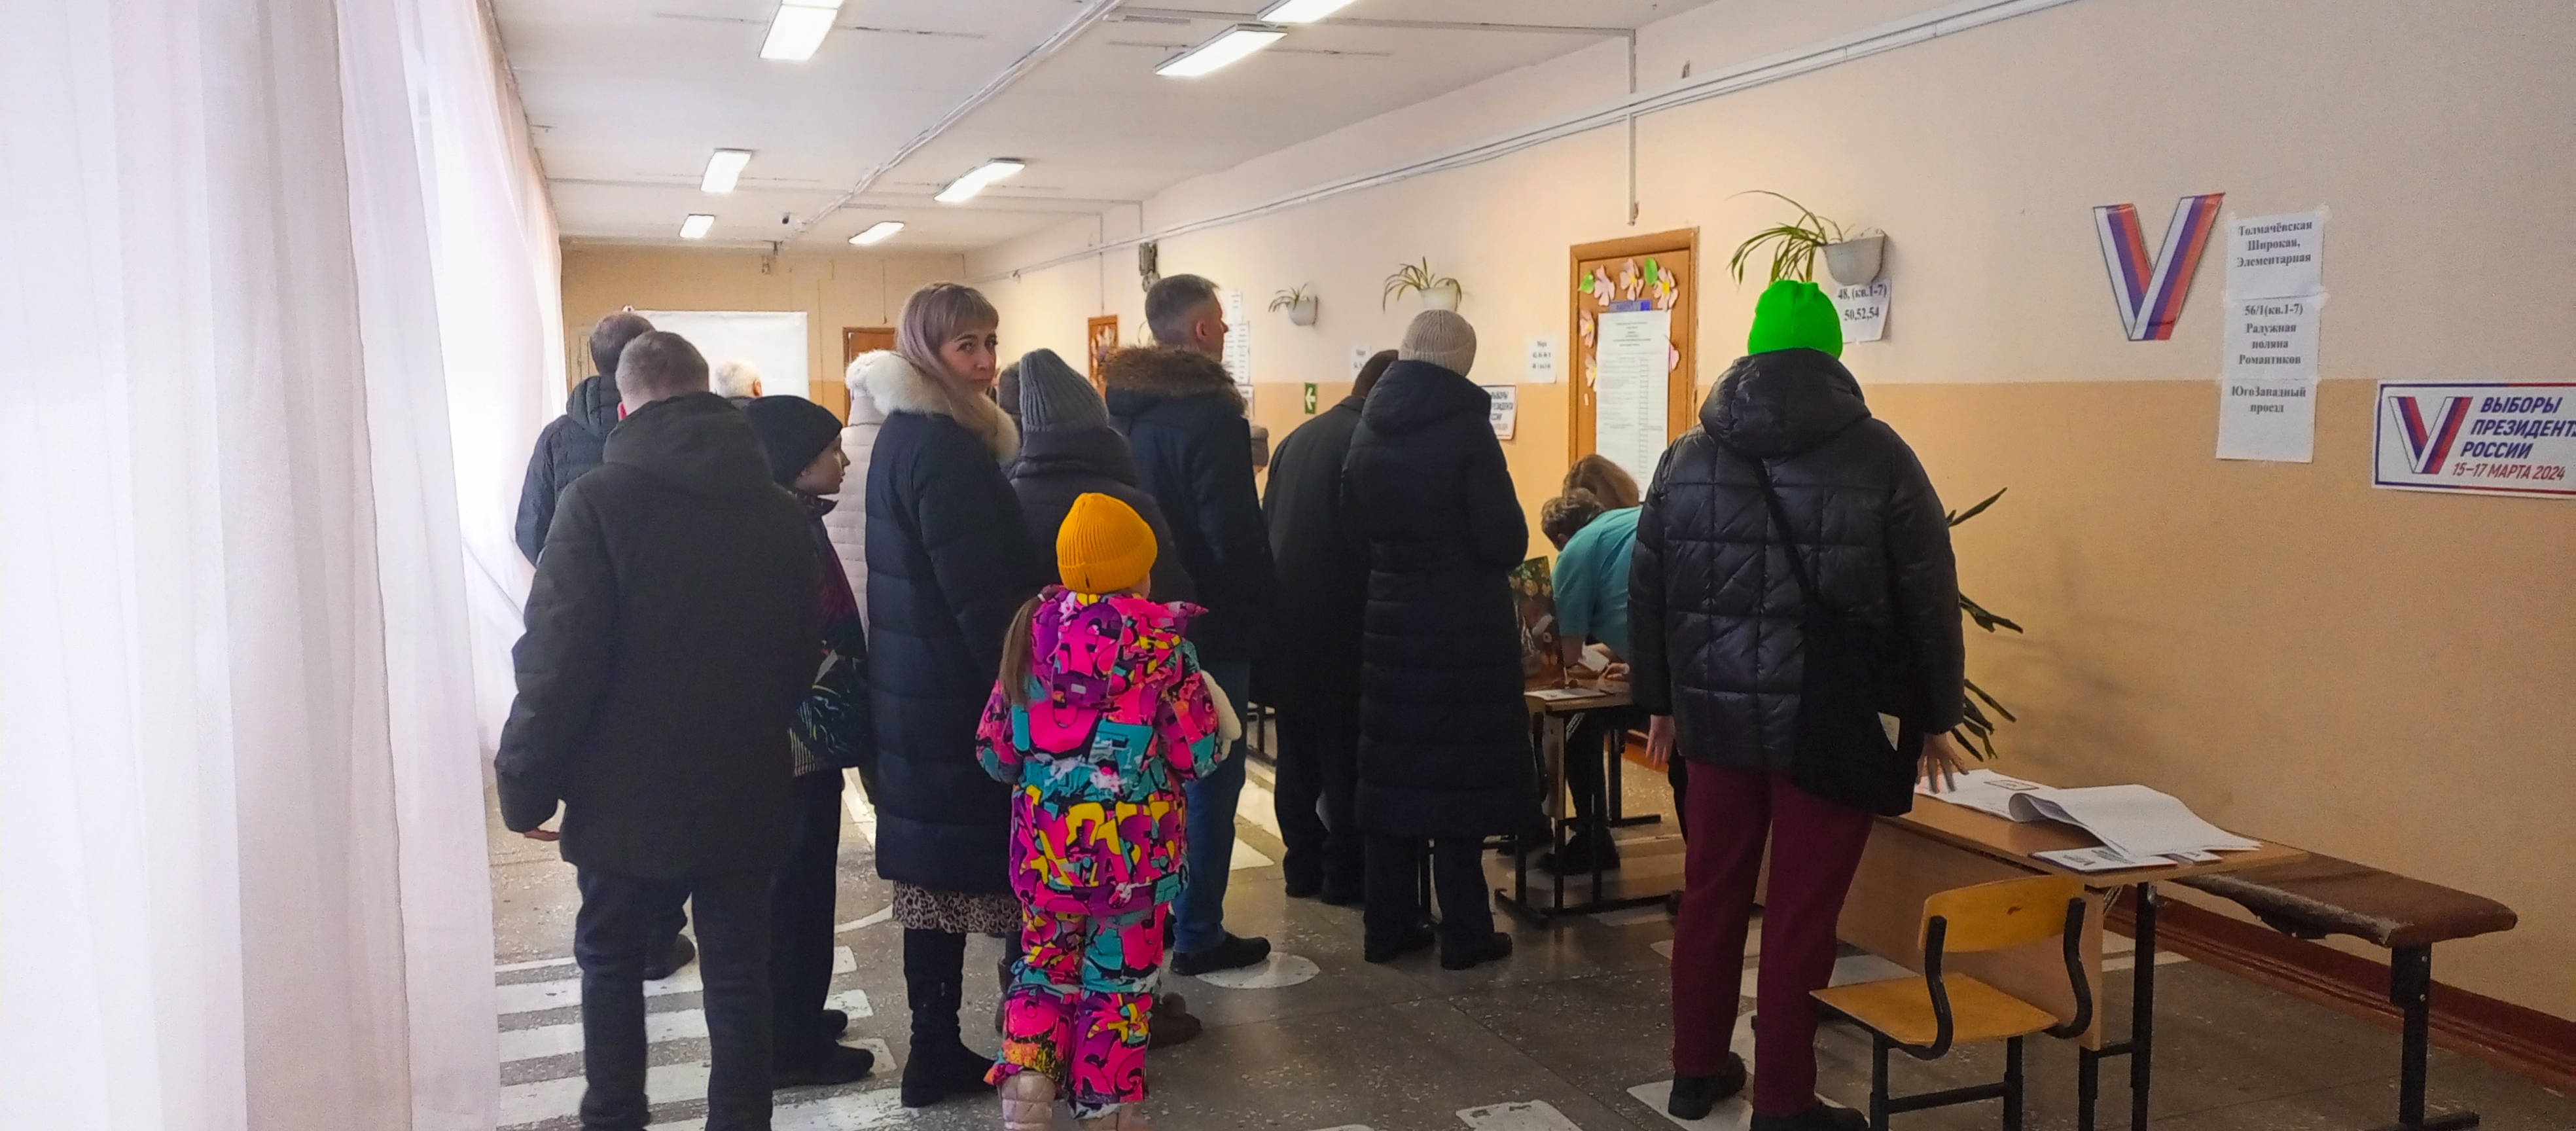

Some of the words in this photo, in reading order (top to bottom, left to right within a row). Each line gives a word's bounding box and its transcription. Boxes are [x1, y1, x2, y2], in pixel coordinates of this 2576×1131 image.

[2238, 221, 2313, 236] Толмачёвская
[2247, 238, 2301, 252] Широкая,
[2236, 254, 2312, 268] Элементарная
[1844, 306, 1880, 321] 50,52,54
[2244, 303, 2304, 317] 56/1(кв.1-7)
[2246, 323, 2297, 336] Радужная
[2251, 340, 2289, 350] поляна
[2238, 354, 2302, 365] Романтиков
[2231, 386, 2306, 397] ЮгоЗападный
[2249, 403, 2285, 415] проезд
[2480, 397, 2564, 414] ВЫБОРЫ
[2470, 420, 2576, 439] ПРЕЗИДЕНТ
[2460, 441, 2534, 459] РОССИИ
[2452, 462, 2488, 477] 15–17
[2487, 463, 2531, 480] МАРТА
[2531, 465, 2566, 480] 2024
